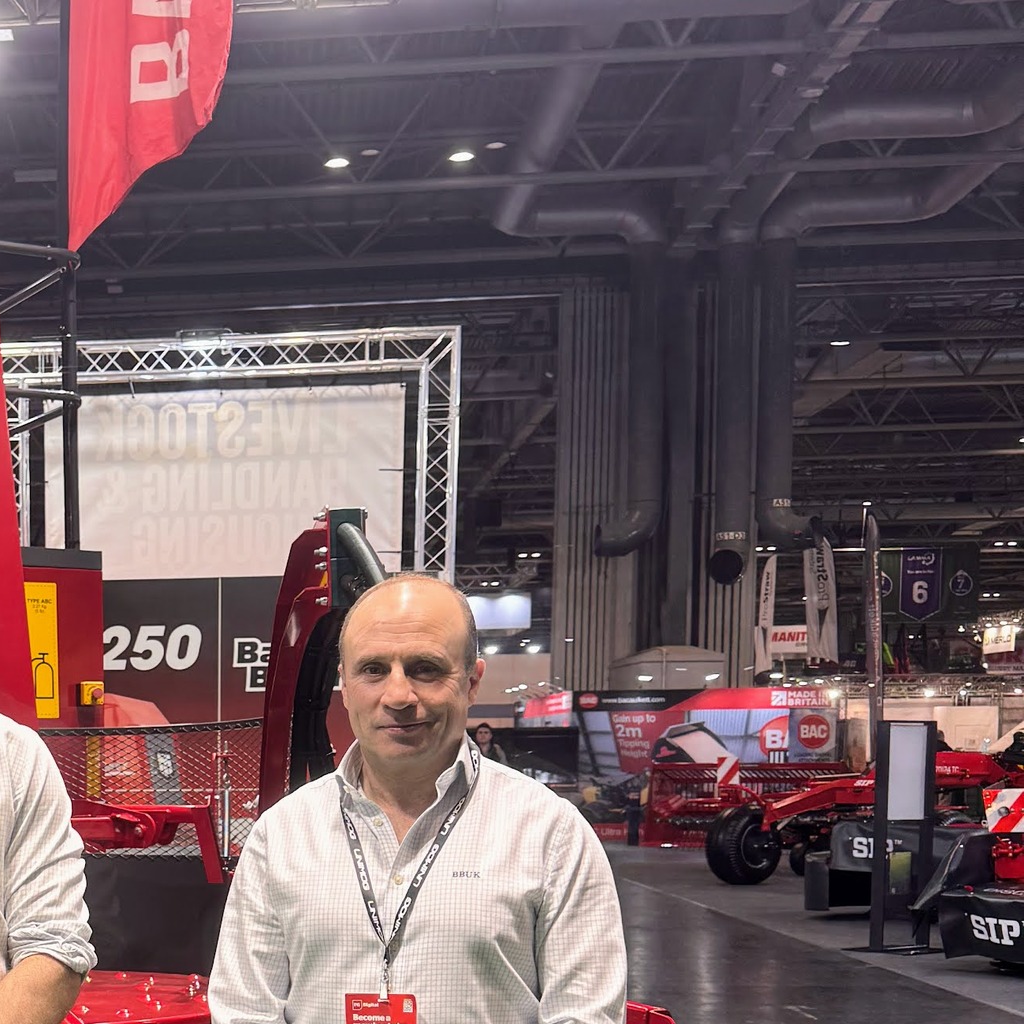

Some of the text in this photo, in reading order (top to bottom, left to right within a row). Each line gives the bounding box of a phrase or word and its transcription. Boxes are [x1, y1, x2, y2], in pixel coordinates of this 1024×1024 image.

[912, 581, 928, 604] 6
[233, 637, 271, 668] Ba
[787, 698, 830, 706] BRITAIN
[612, 714, 656, 724] Gain up to
[616, 724, 642, 738] 2m
[800, 725, 828, 738] BAC
[618, 739, 650, 748] Tipping
[854, 779, 874, 787] SIP
[440, 797, 466, 836] UNIMOG
[354, 848, 371, 891] UNIMOG
[413, 844, 440, 889] UNIMOG
[452, 871, 481, 879] BBUK
[970, 913, 1021, 947] SIP
